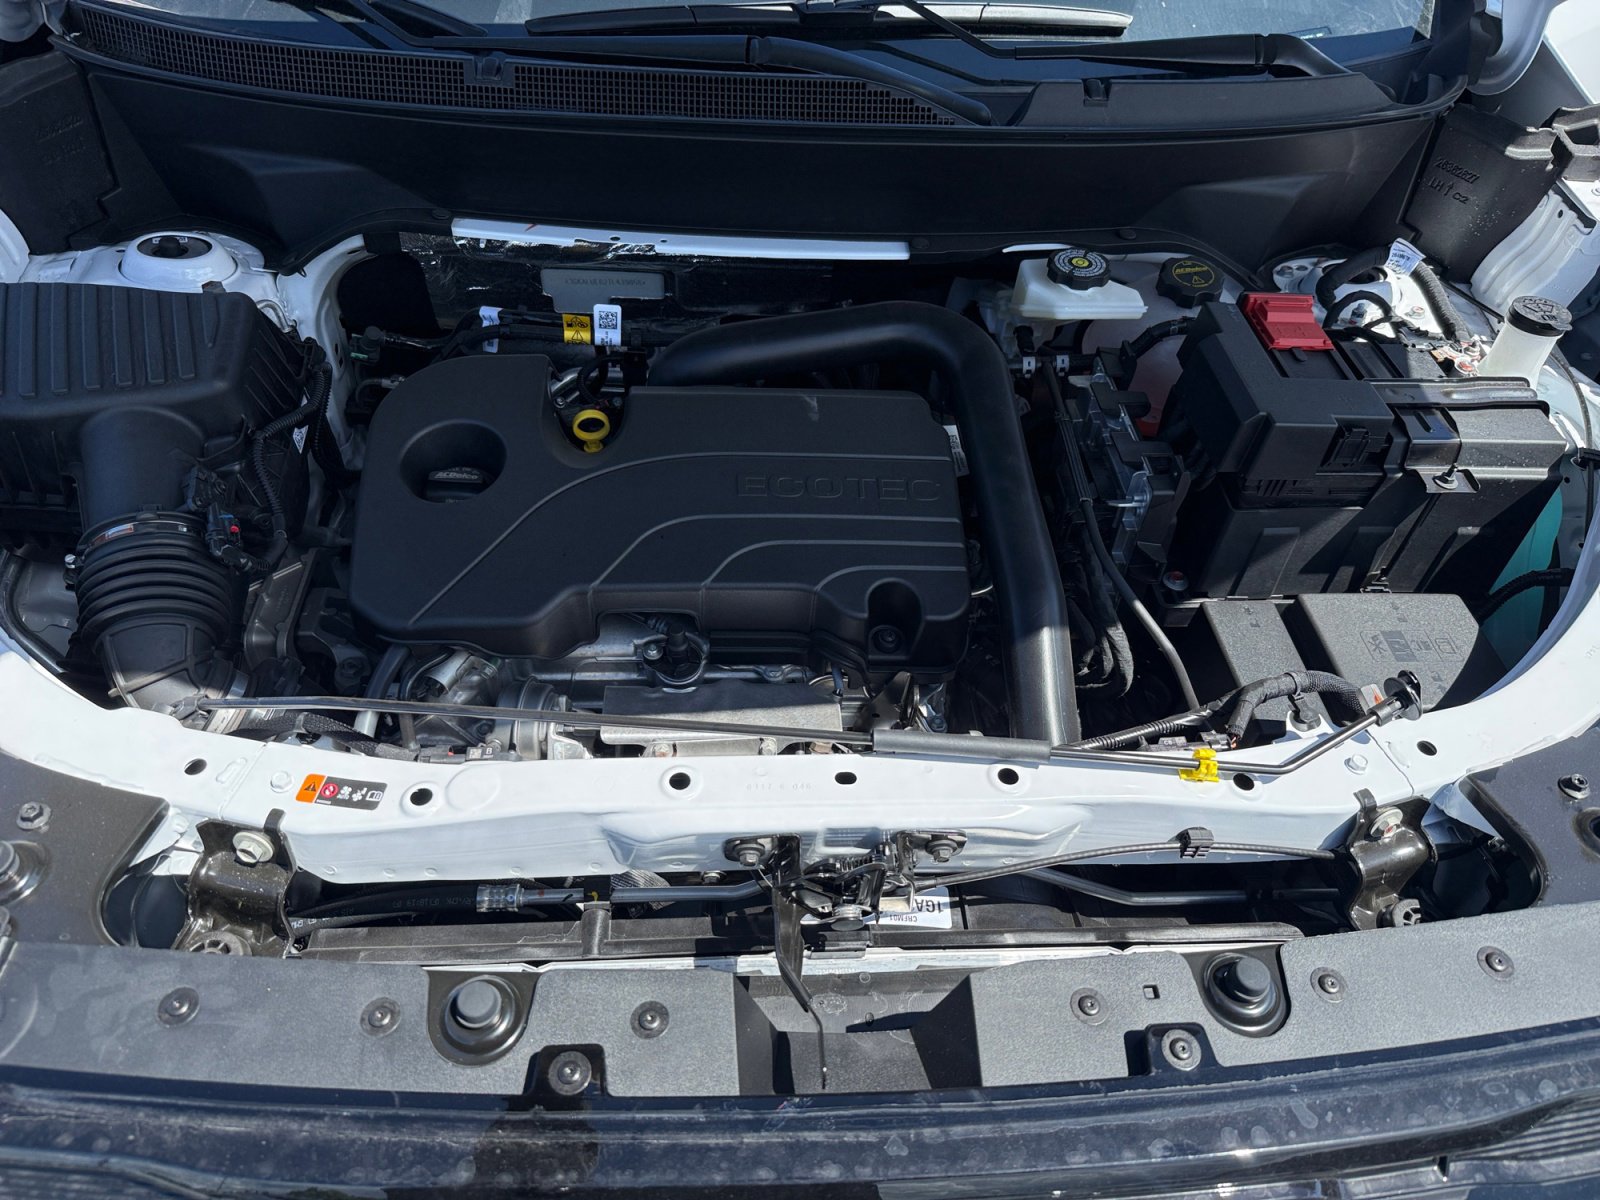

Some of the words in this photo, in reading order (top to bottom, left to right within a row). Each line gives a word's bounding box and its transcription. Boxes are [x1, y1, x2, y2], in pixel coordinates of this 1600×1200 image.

[433, 471, 479, 480] ACDelco
[737, 473, 942, 502] ECOTEC
[911, 898, 944, 914] 1GA
